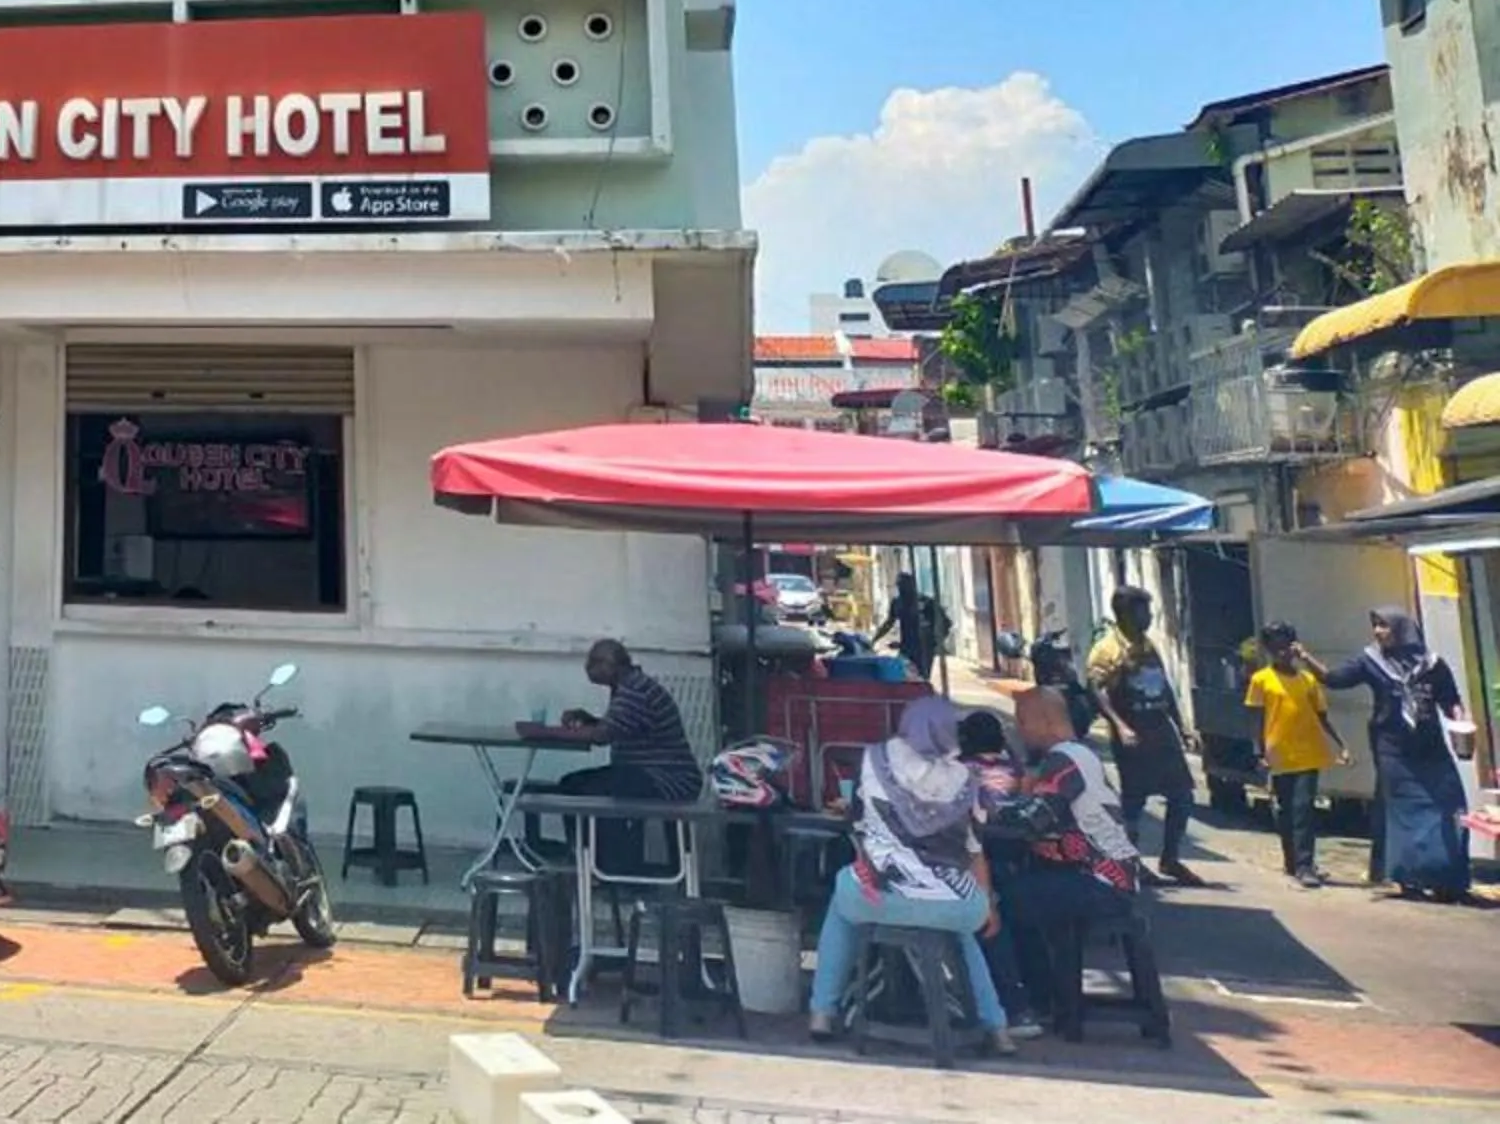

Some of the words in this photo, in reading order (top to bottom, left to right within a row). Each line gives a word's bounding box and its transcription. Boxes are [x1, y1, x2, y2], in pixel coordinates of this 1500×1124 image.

[57, 95, 207, 159] CITY
[227, 89, 447, 157] HOTEL
[221, 194, 269, 212] Google
[360, 197, 395, 216] App
[396, 196, 440, 213] Store
